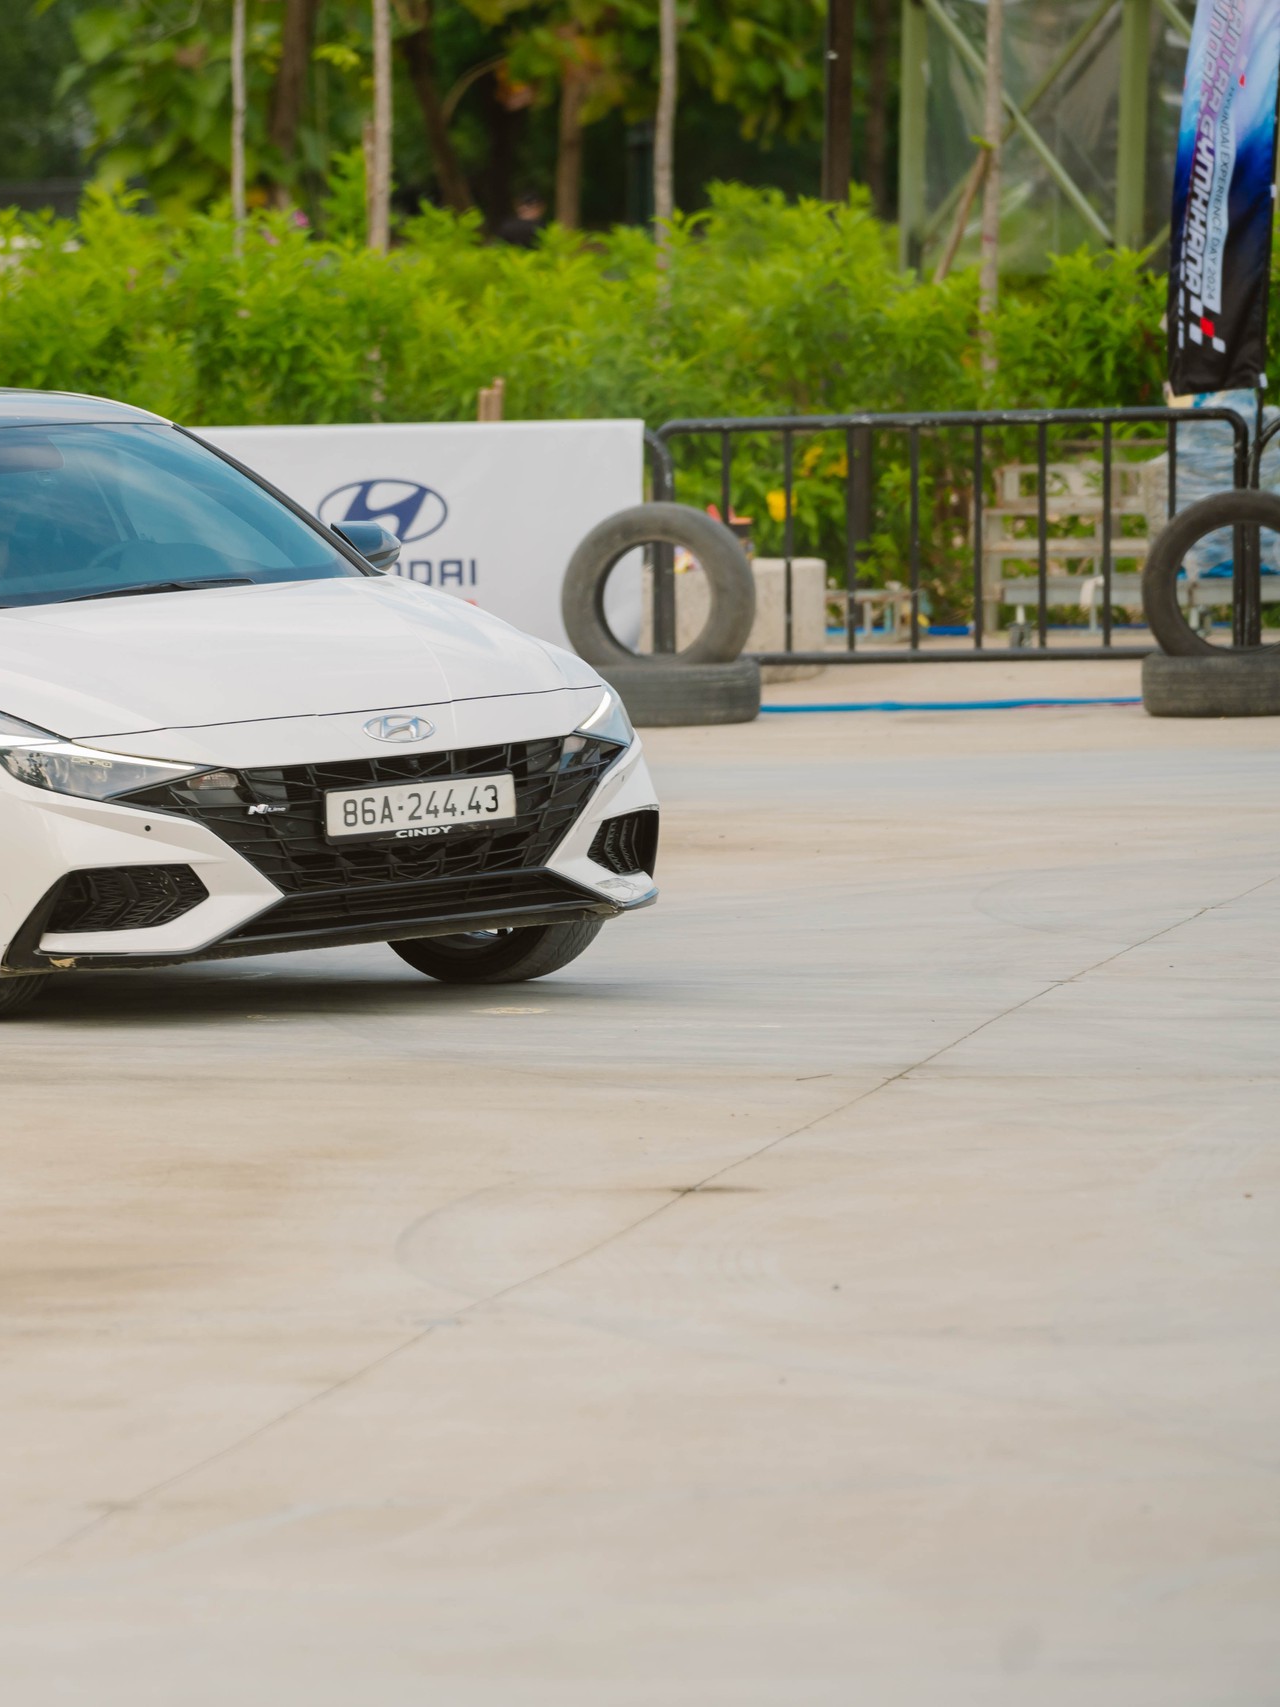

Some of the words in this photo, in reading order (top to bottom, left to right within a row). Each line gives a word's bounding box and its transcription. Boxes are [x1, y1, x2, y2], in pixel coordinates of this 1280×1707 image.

[1210, 151, 1231, 233] EXPERIENCE
[1206, 236, 1220, 266] DAY
[1207, 268, 1217, 300] 2024
[395, 826, 453, 839] CINDY
